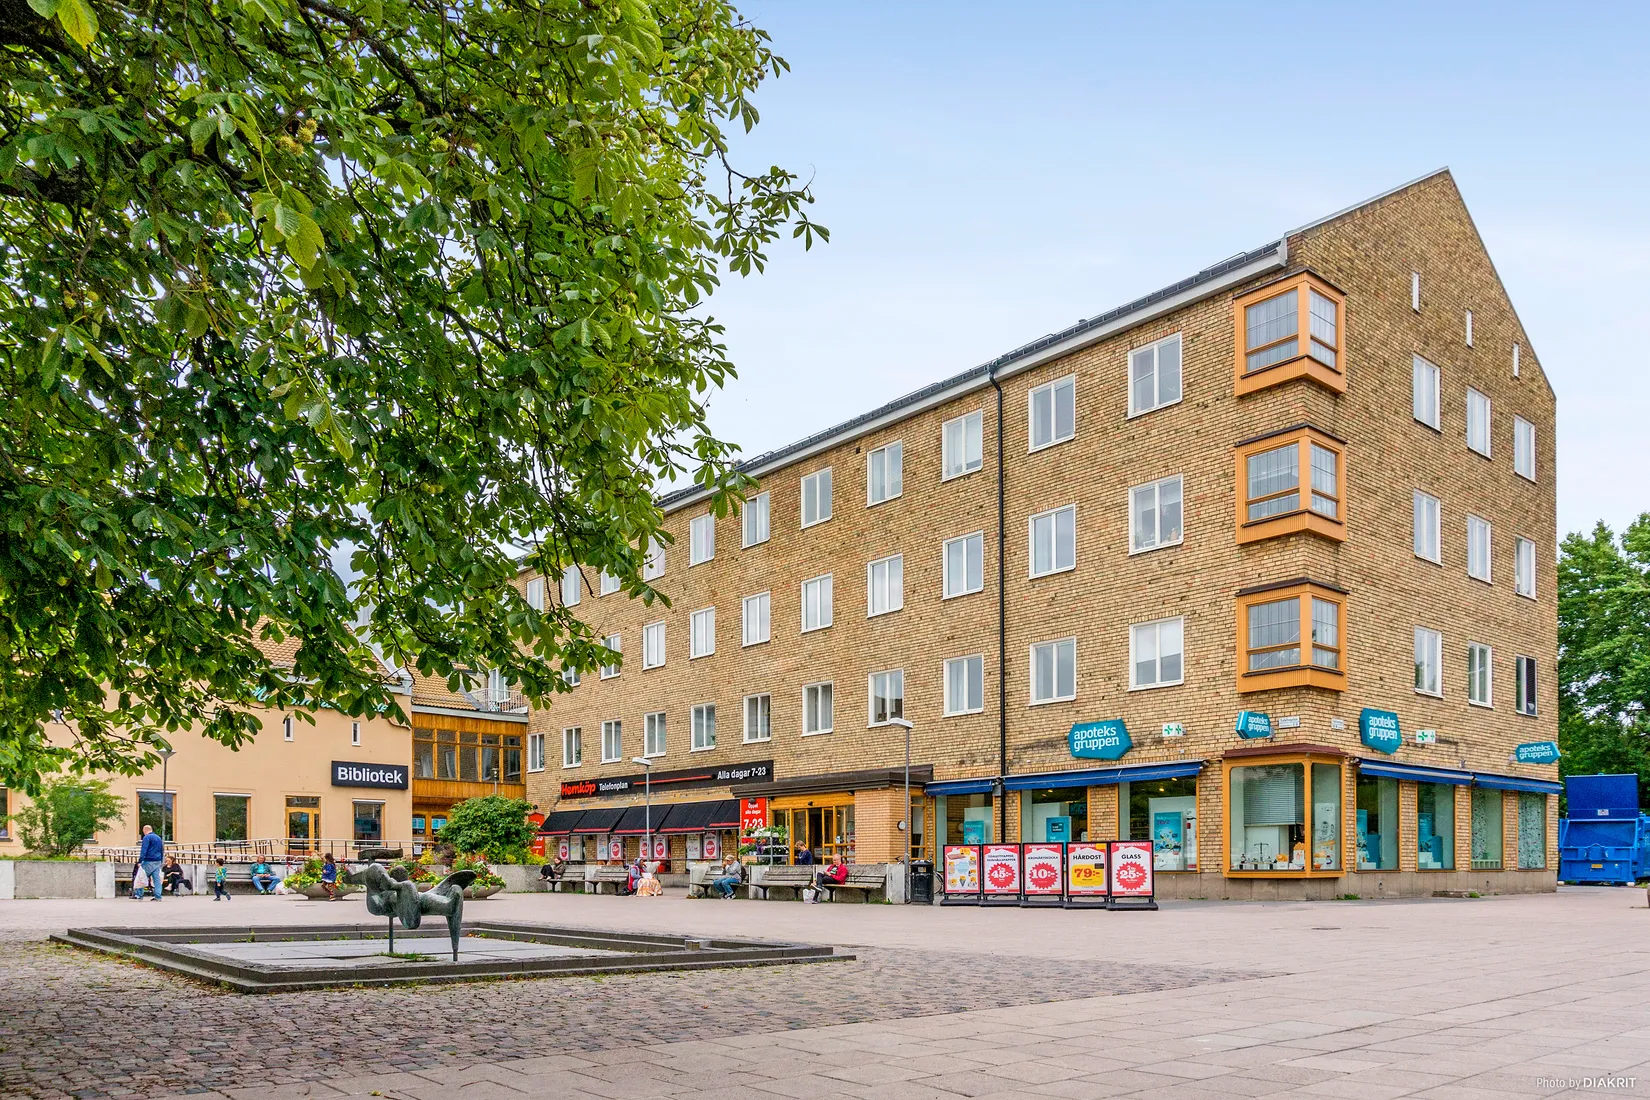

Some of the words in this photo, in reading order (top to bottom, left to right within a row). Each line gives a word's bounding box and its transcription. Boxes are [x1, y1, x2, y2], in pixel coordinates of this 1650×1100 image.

[1248, 716, 1268, 725] apoteks
[1368, 716, 1396, 728] apoteks
[1074, 726, 1116, 740] apoteks
[1248, 723, 1269, 732] gruppen
[1368, 726, 1398, 741] gruppen
[1074, 736, 1120, 752] gruppen
[1520, 744, 1550, 753] apoteks
[1520, 750, 1552, 760] gruppen
[337, 766, 402, 784] Bibliotek
[717, 770, 730, 780] Alla
[731, 770, 750, 779] dagar
[752, 766, 766, 777] 7-23
[562, 781, 596, 796] Hemköp
[599, 782, 628, 791] Telefonplan
[744, 818, 763, 829] 7-23
[1032, 869, 1055, 878] 10:-
[1074, 868, 1100, 878] 79:-
[1120, 870, 1143, 879] 25:-
